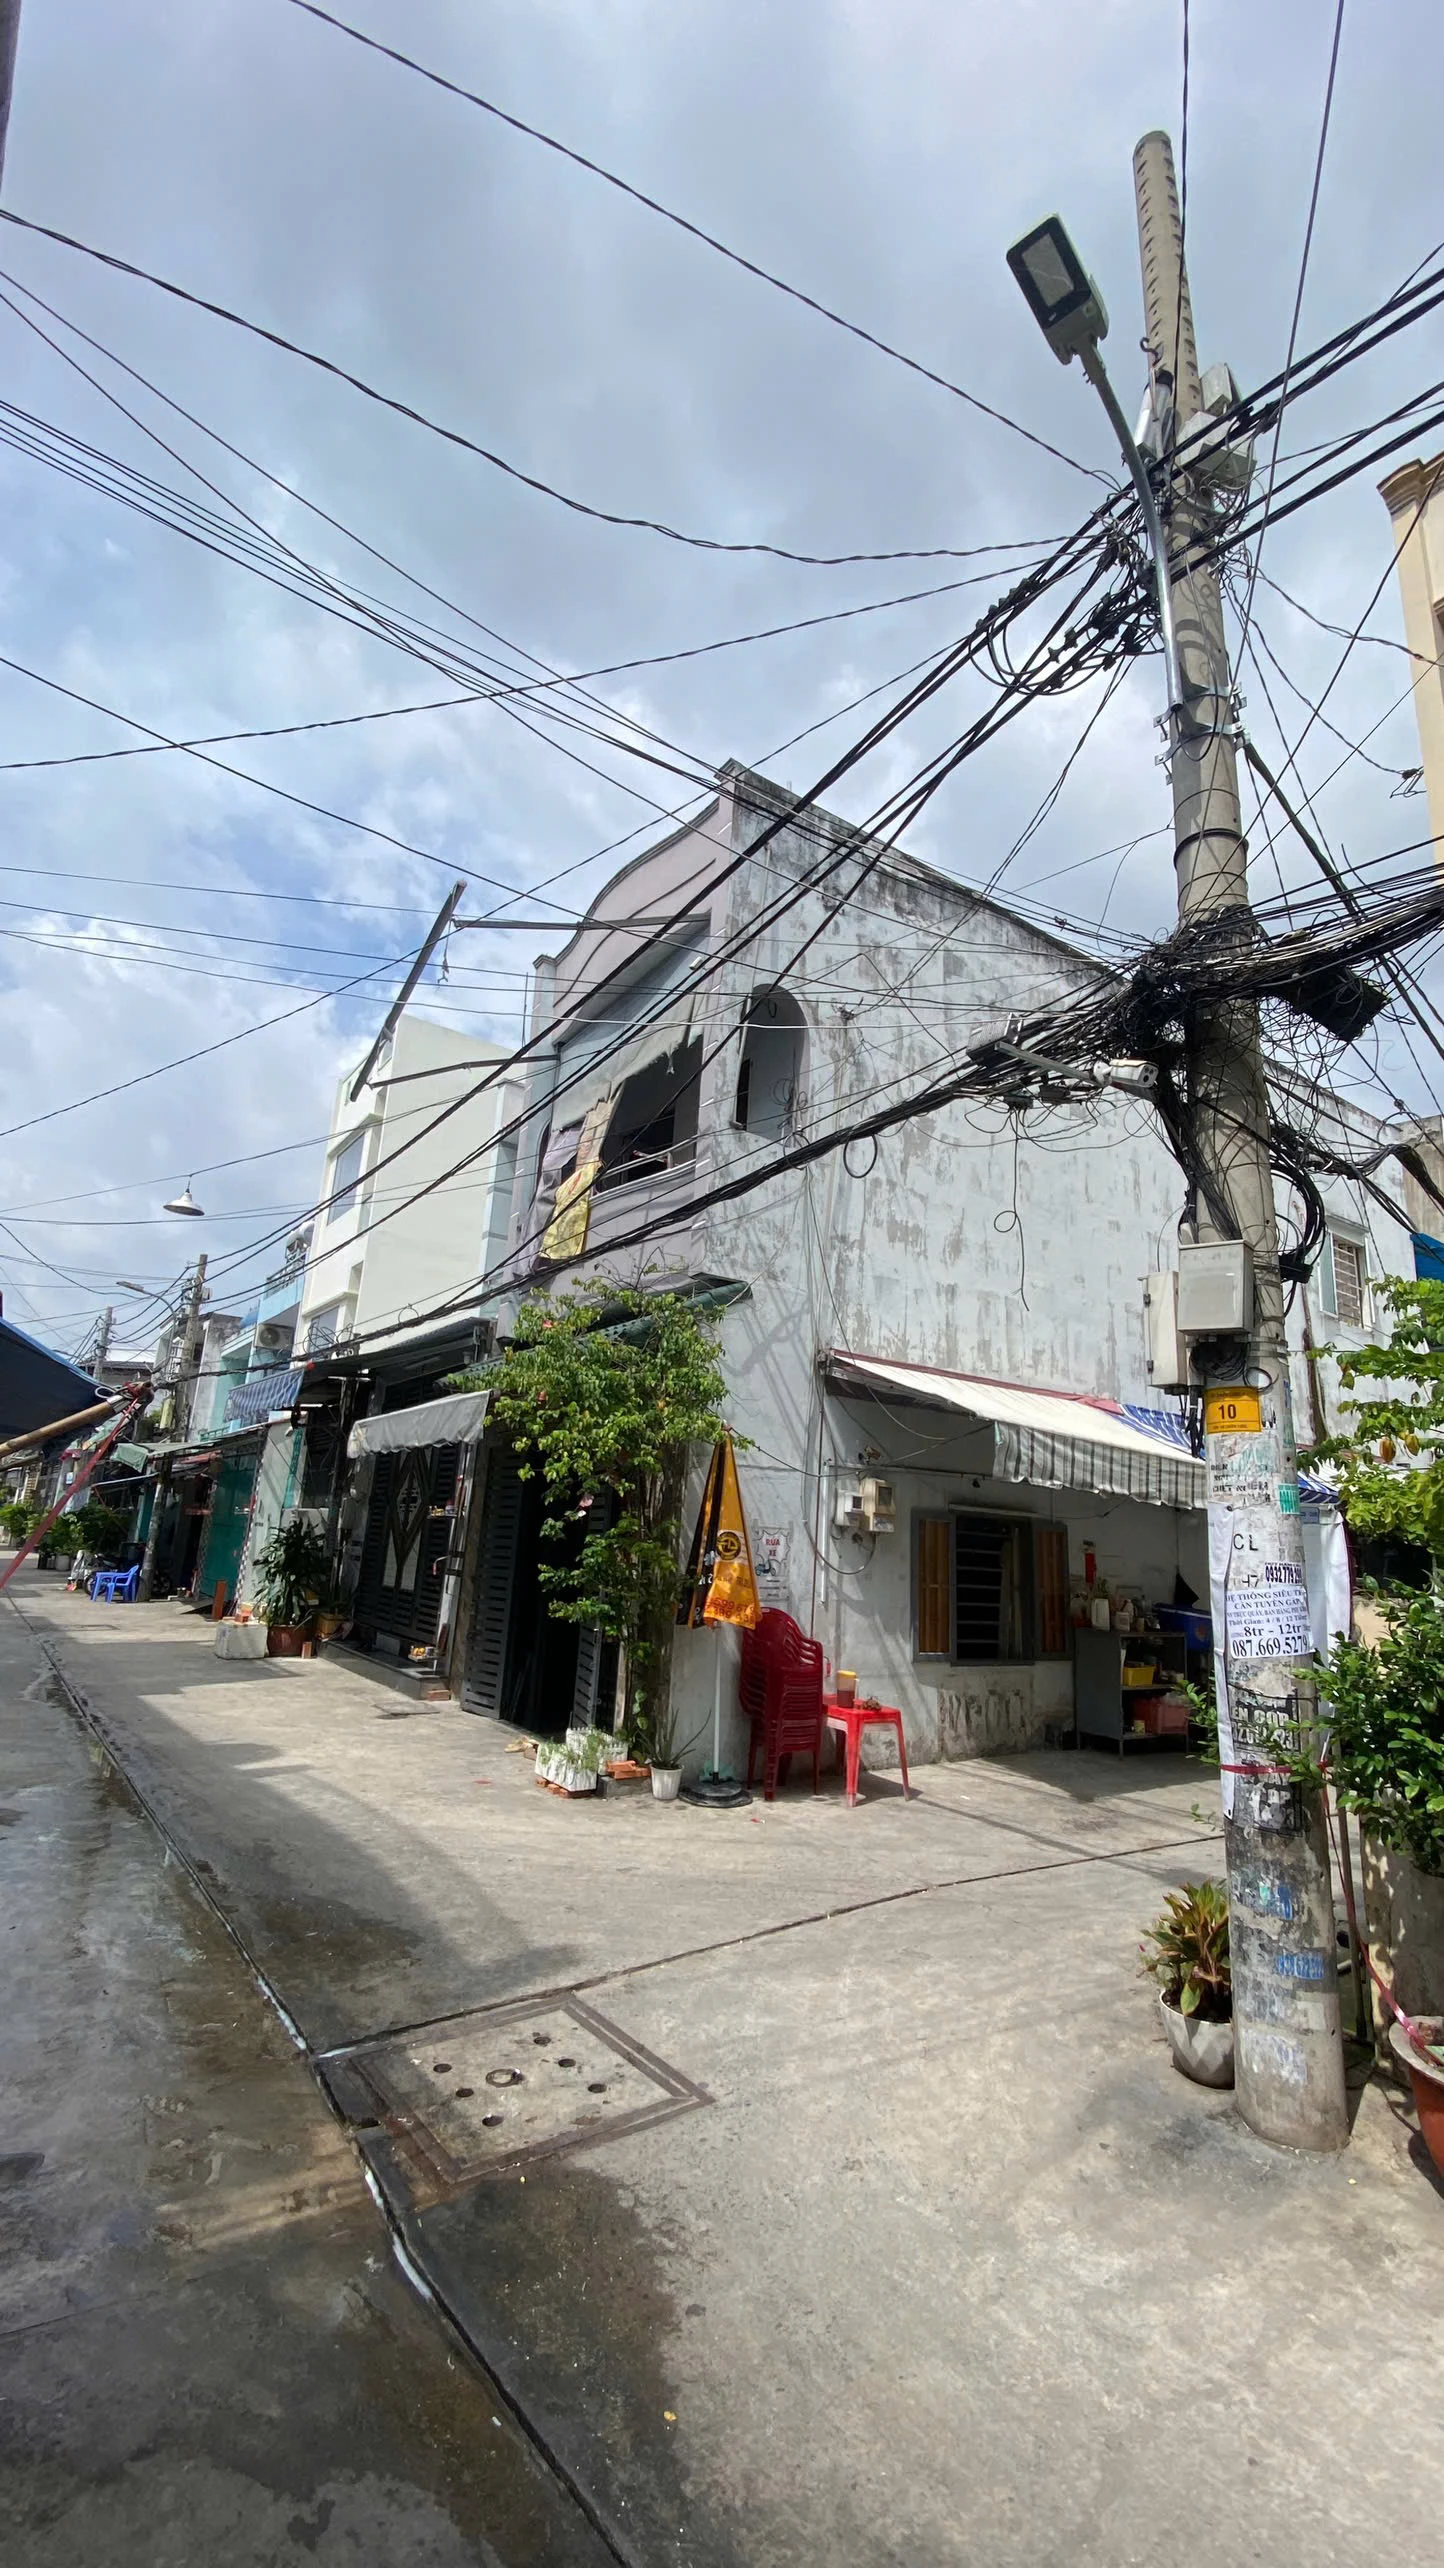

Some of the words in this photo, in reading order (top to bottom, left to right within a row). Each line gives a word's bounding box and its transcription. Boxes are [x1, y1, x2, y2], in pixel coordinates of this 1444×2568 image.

[1218, 1404, 1236, 1420] 10
[1243, 1626, 1264, 1637] 8tr
[1278, 1623, 1302, 1635] 12tr
[1232, 1635, 1308, 1657] 087.669.5279
